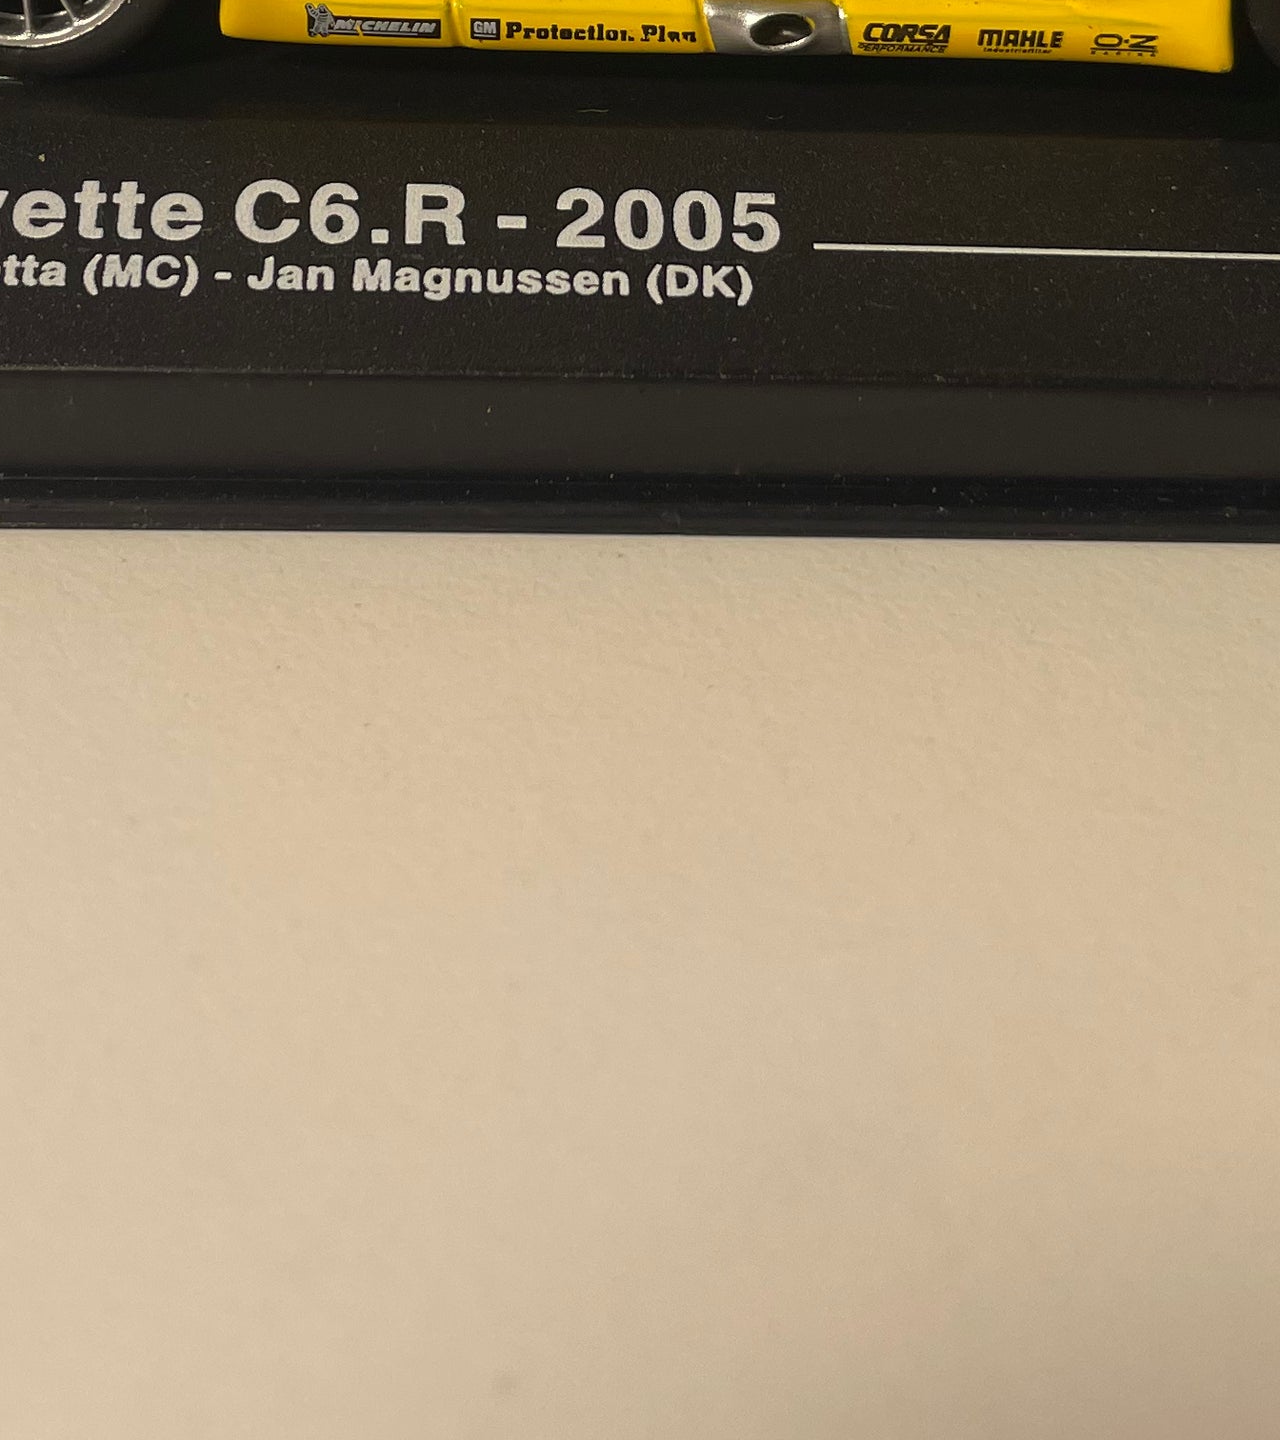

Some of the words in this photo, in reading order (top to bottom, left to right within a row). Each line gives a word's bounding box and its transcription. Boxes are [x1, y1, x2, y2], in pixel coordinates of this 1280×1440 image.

[333, 18, 438, 35] MICHELIN
[472, 20, 497, 35] GM
[863, 23, 951, 43] CORSA
[977, 29, 1064, 48] MAHLE
[234, 178, 466, 246] C6.R
[556, 187, 781, 253] 2005
[82, 253, 199, 297] (MC)
[246, 255, 335, 292] Jan
[352, 258, 630, 301] Magnussen
[646, 263, 753, 307] (DK)
